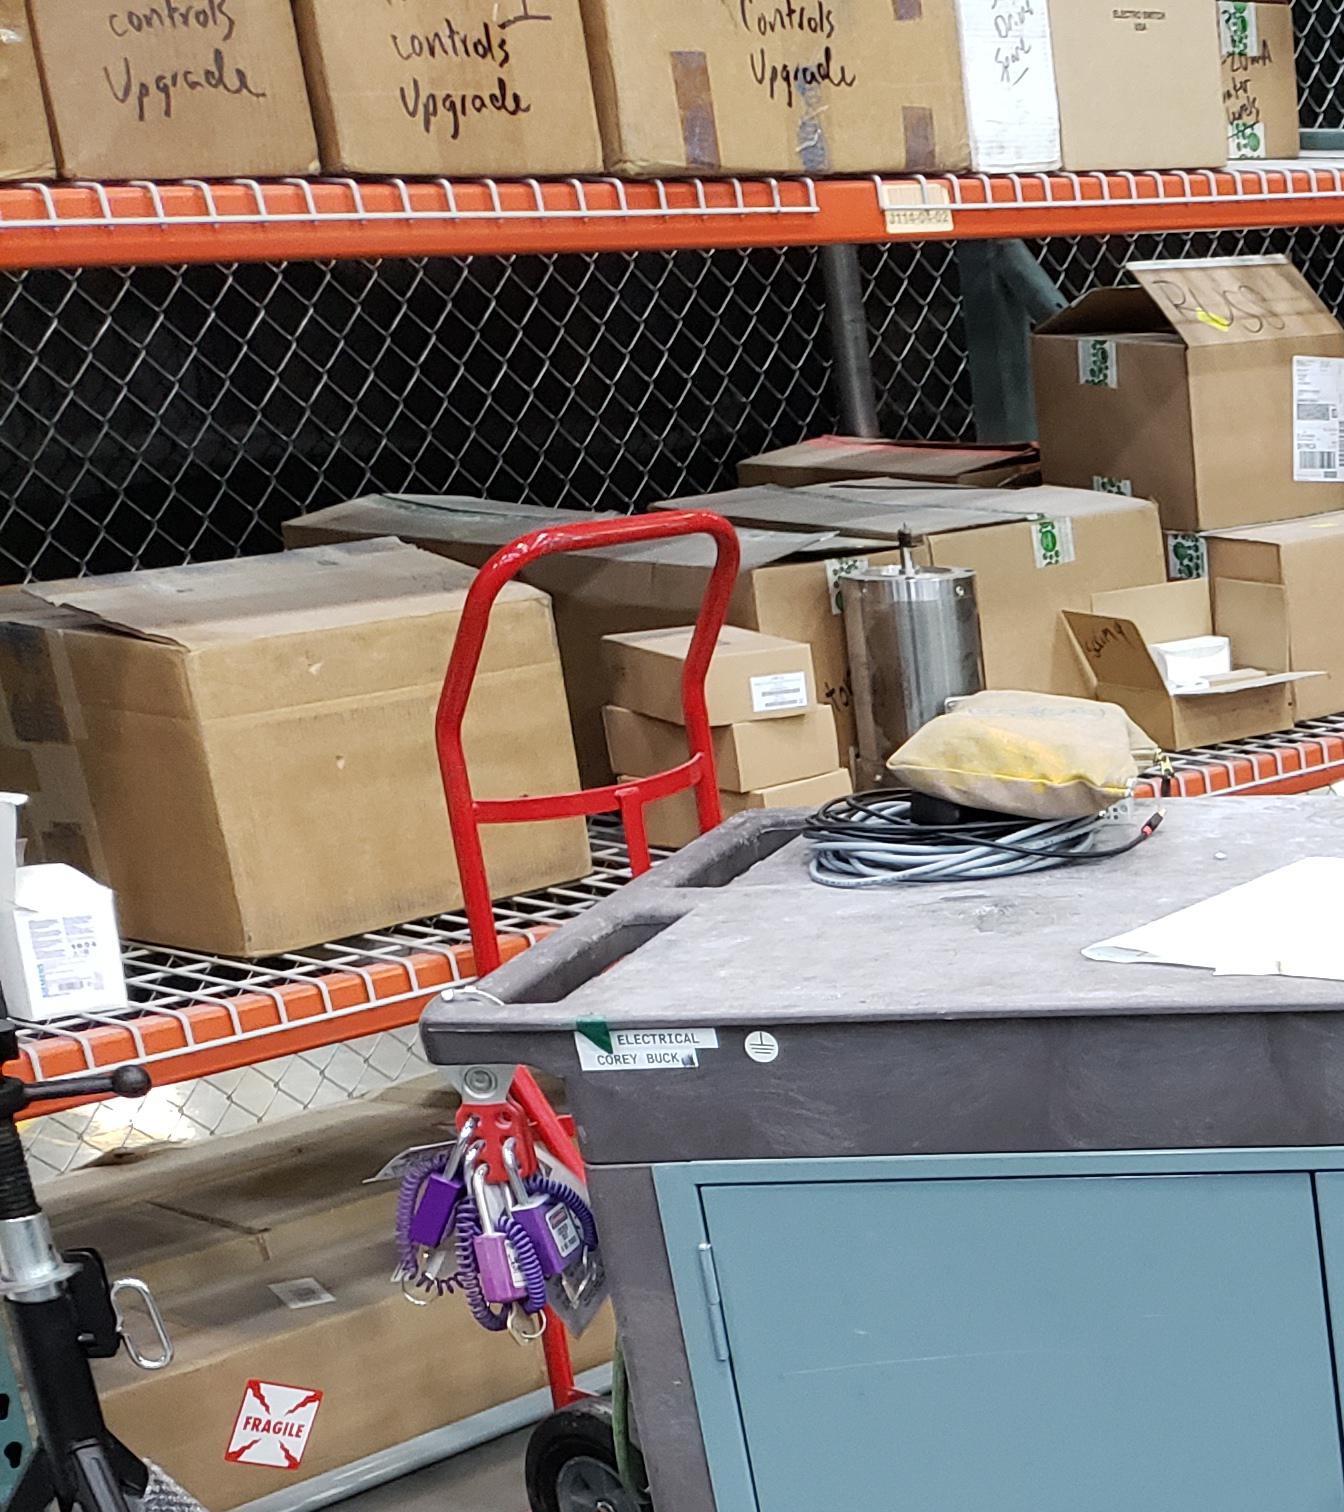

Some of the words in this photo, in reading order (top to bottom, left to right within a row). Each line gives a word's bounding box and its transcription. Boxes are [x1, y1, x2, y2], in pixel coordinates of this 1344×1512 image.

[390, 17, 510, 67] controls
[103, 47, 266, 121] Upgrade
[750, 46, 856, 108] Upgrade
[399, 77, 531, 139] Upgrade
[596, 1054, 638, 1066] COREY
[646, 1052, 680, 1064] BUCK
[616, 1032, 700, 1046] ELECTRICAL
[242, 1415, 305, 1439] FRAGILE
